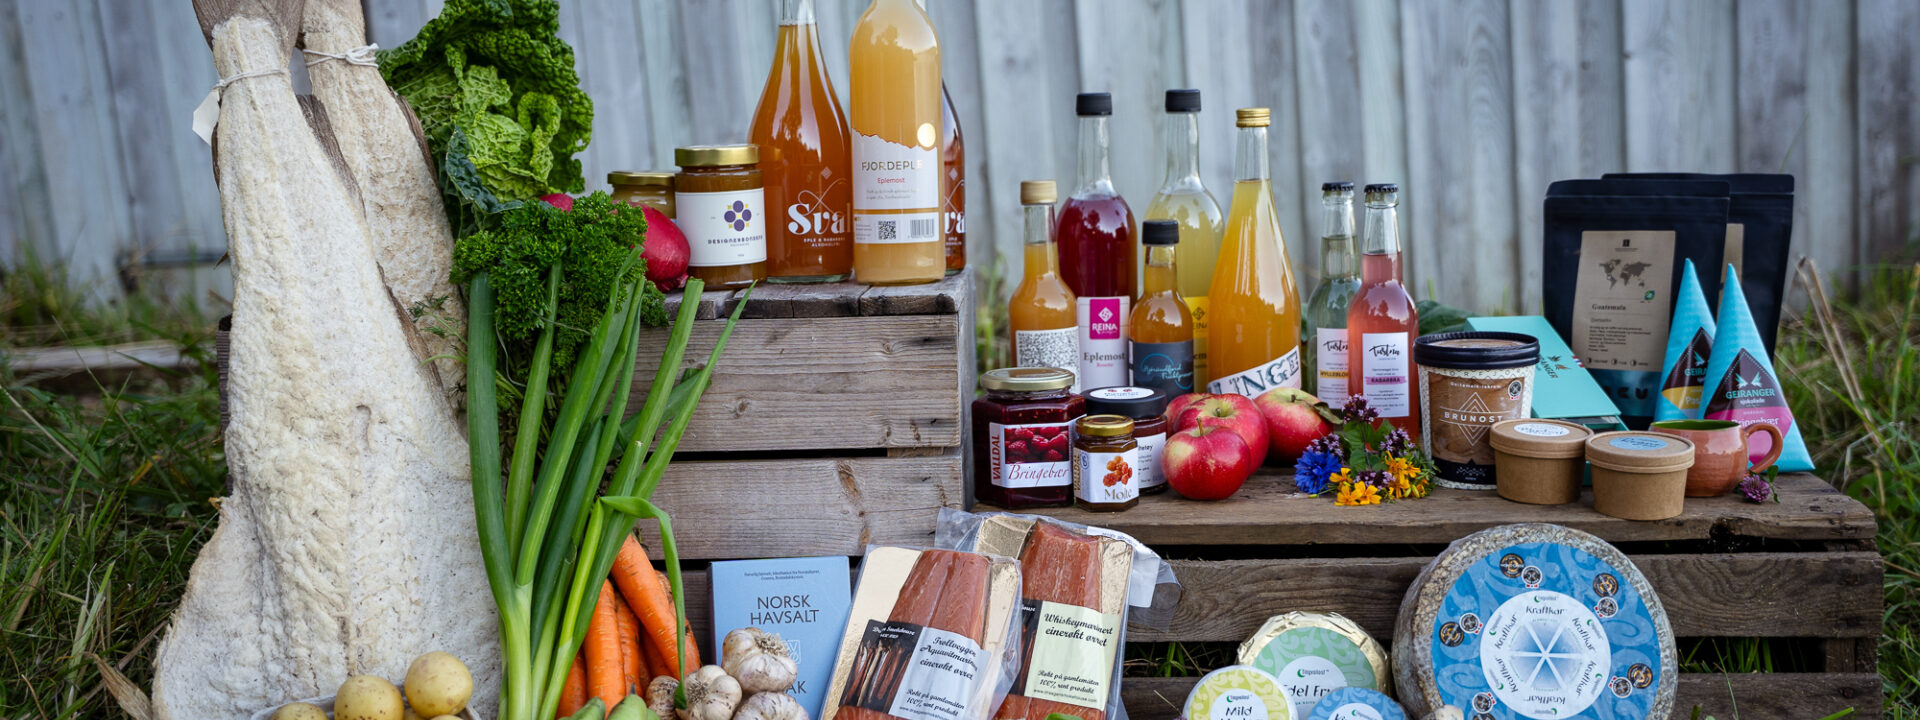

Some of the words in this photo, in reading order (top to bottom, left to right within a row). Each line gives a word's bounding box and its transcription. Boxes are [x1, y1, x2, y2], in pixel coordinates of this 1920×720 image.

[861, 160, 923, 171] FJORDEPLE
[1092, 323, 1118, 334] REINA
[1083, 352, 1125, 362] Eplemost
[1685, 368, 1707, 376] GEIRA
[1725, 388, 1775, 399] GEIRANGER
[1444, 411, 1502, 423] BRUNOST
[991, 434, 1000, 480] VALLDAL
[1008, 463, 1069, 486] Bringebær
[757, 595, 811, 609] NORSK
[750, 610, 819, 625] HAVSALT
[1044, 613, 1113, 634] Whiskeymarinert
[933, 636, 976, 657] Trollveggen
[1063, 674, 1099, 686] gamlemåten
[786, 681, 807, 694] AK
[1040, 679, 1056, 689] 100%
[1069, 684, 1094, 694] produkt
[1313, 686, 1330, 697] Fr
[907, 697, 922, 708] 100%
[934, 704, 959, 716] produkt
[1226, 706, 1252, 716] Mild
